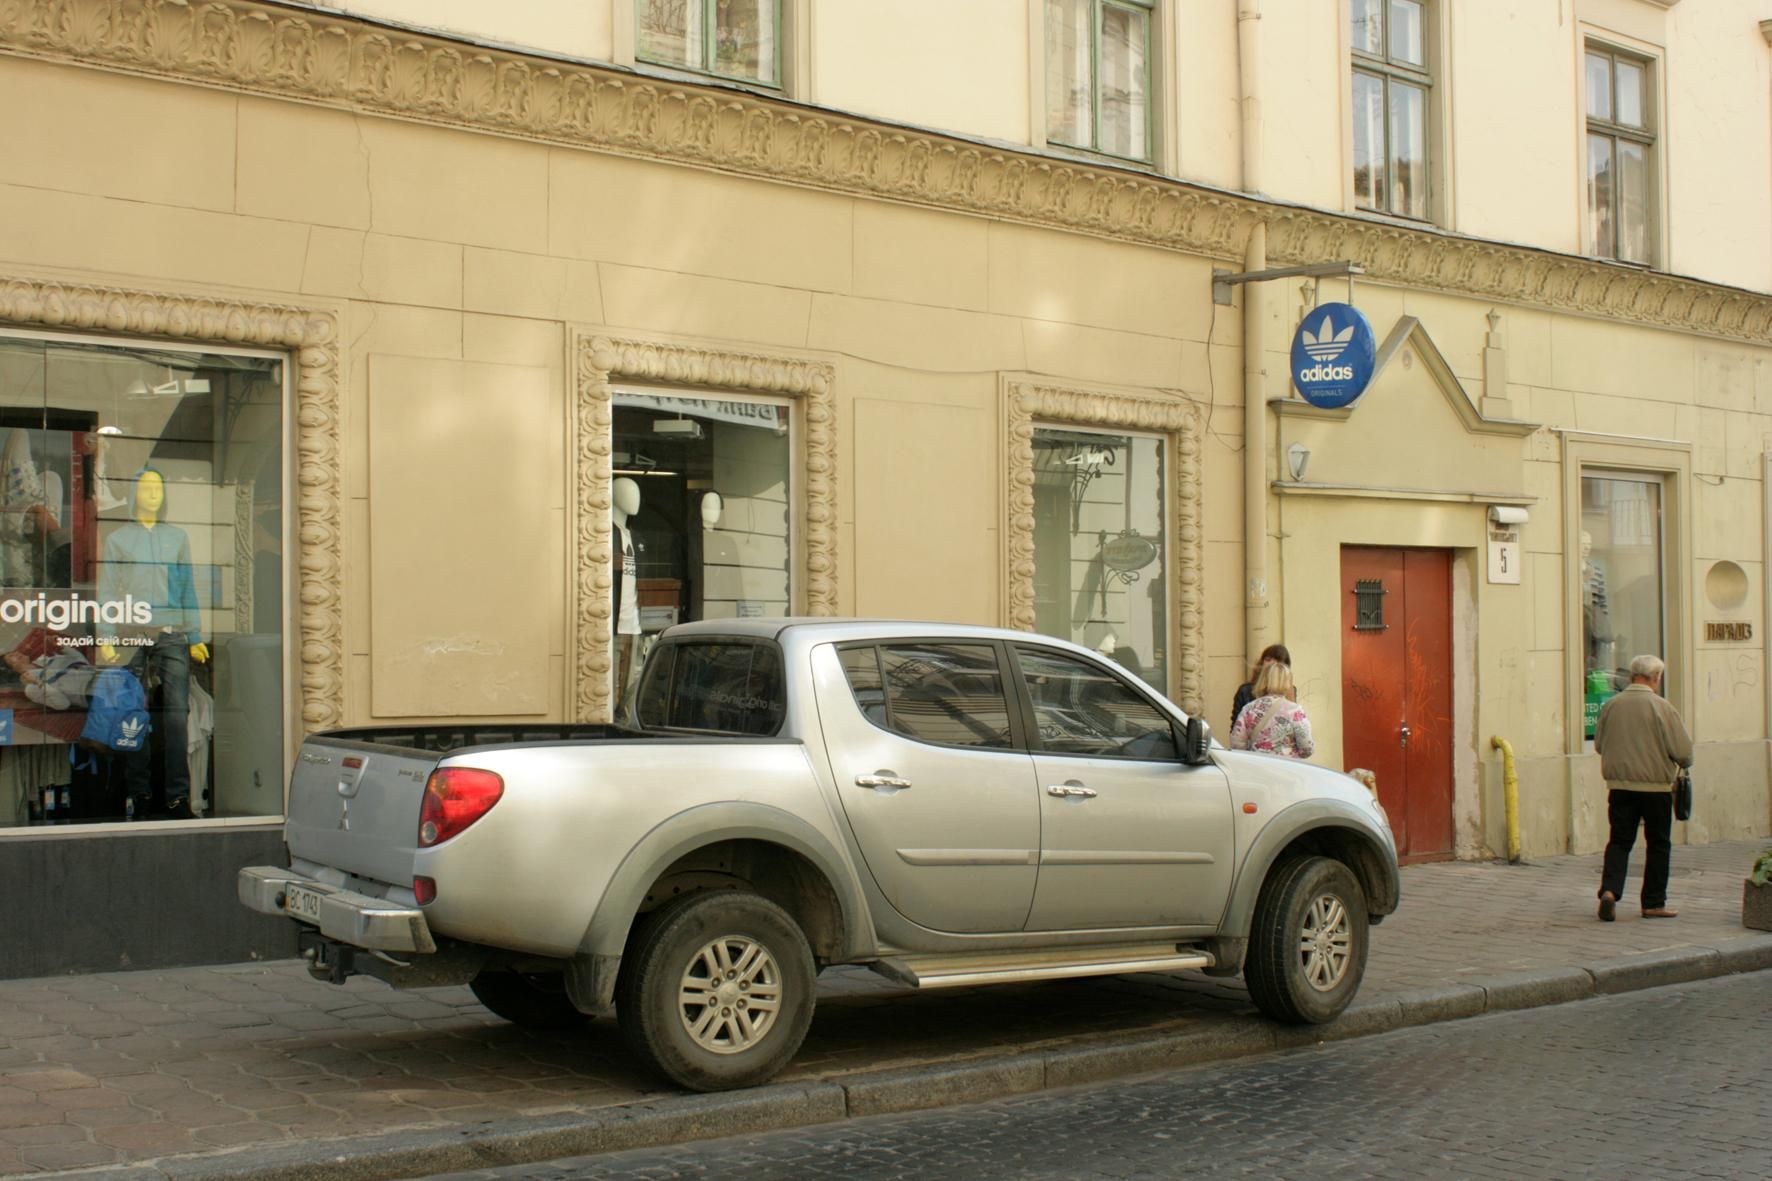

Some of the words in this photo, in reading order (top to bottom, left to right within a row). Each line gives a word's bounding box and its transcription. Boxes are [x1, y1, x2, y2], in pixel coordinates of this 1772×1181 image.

[1301, 364, 1353, 382] adidas
[1500, 547, 1507, 574] 5
[0, 593, 152, 630] originals
[56, 635, 94, 647] задай
[122, 637, 155, 647] стиль
[290, 889, 301, 911] BC
[303, 892, 318, 917] 1743
